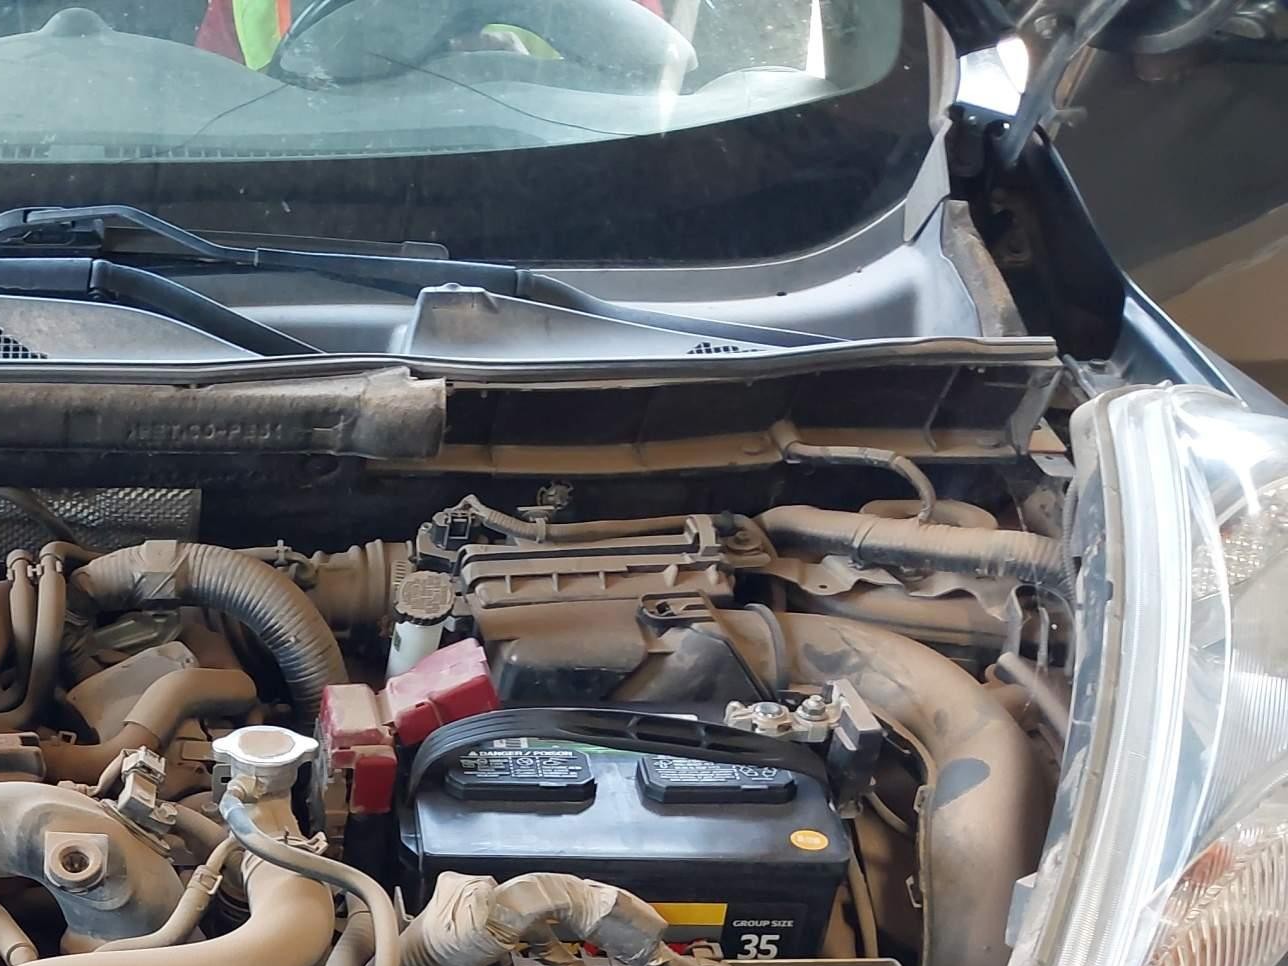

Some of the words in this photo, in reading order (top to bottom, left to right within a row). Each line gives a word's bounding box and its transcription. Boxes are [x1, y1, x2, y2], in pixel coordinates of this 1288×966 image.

[732, 919, 770, 928] GROUP
[771, 919, 794, 928] SIZE
[737, 934, 780, 960] 35
